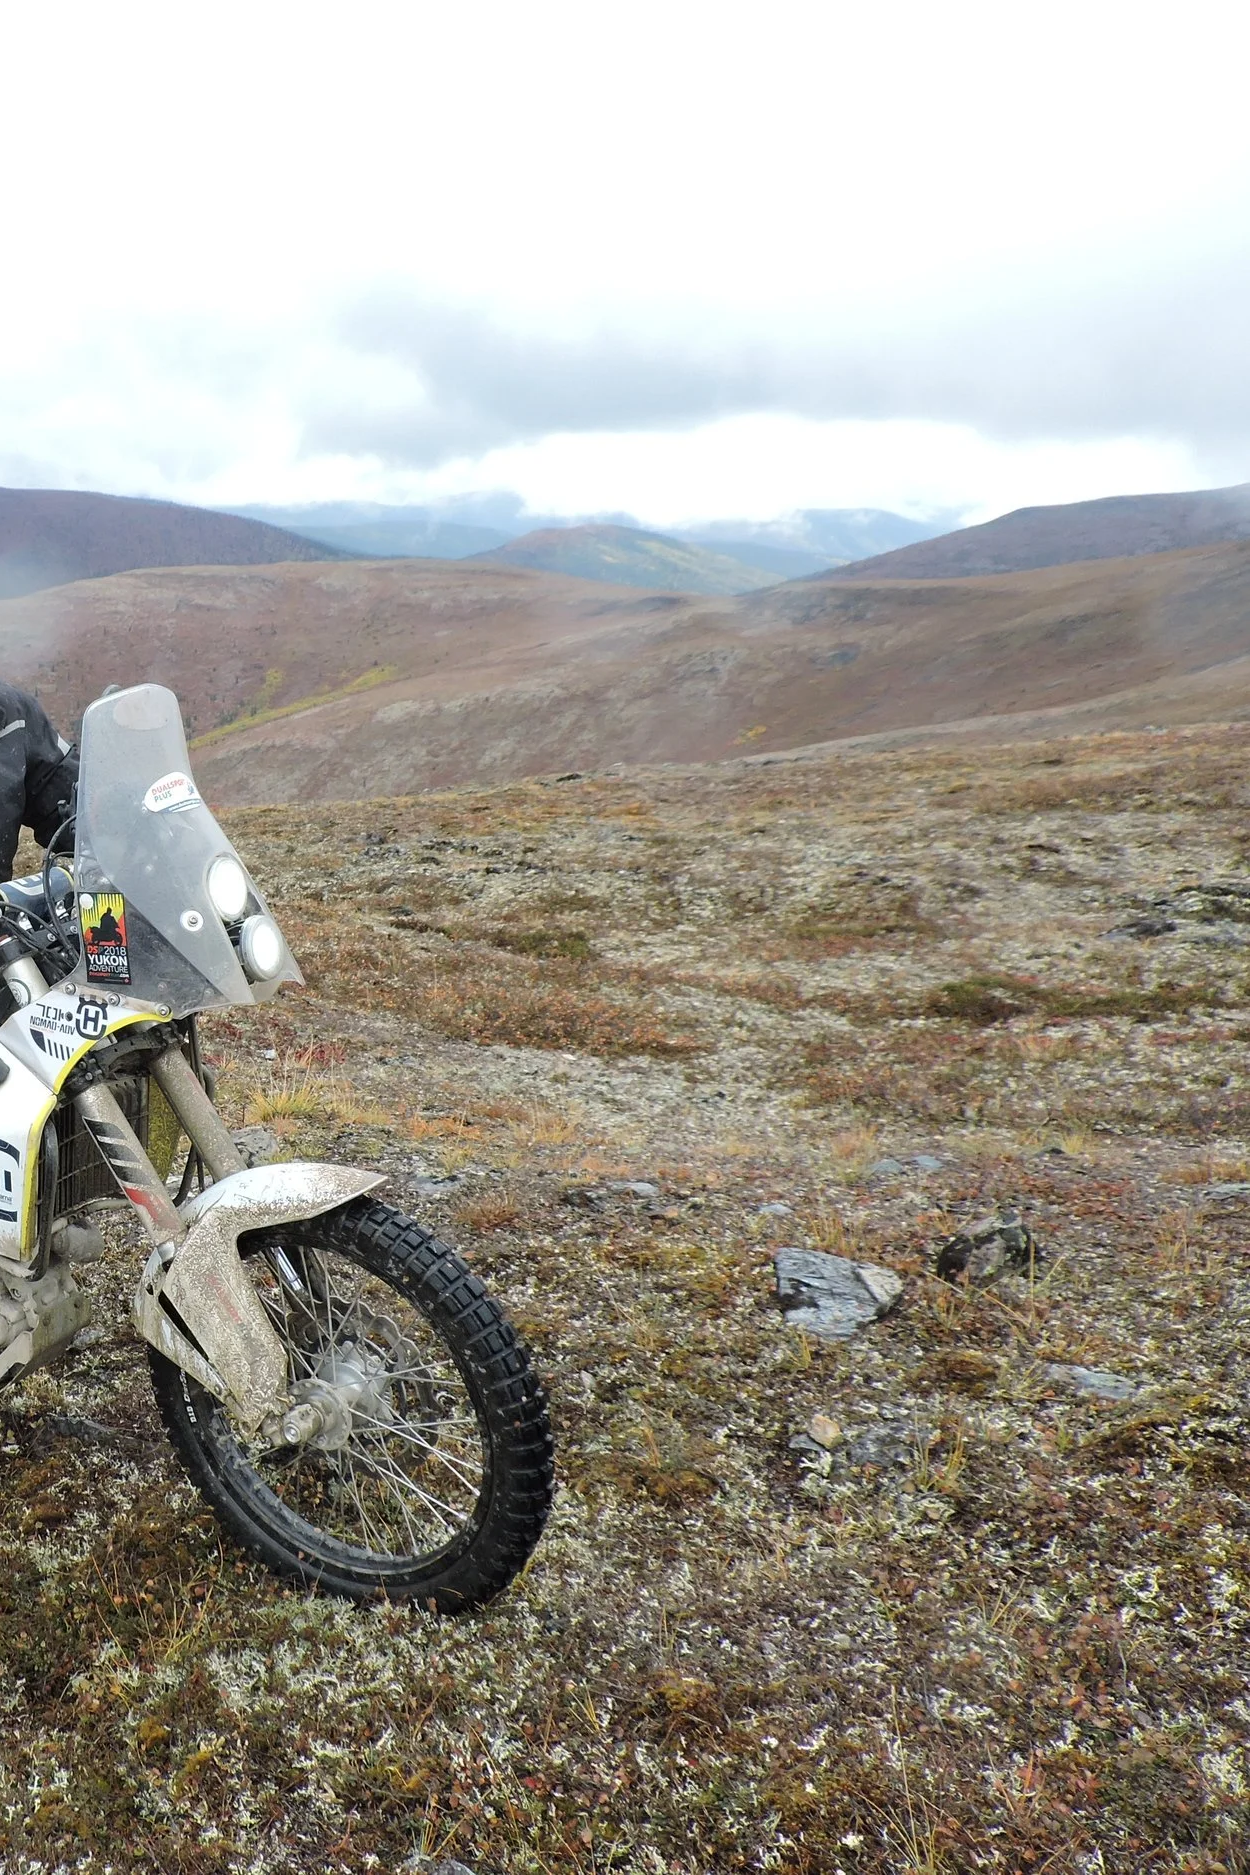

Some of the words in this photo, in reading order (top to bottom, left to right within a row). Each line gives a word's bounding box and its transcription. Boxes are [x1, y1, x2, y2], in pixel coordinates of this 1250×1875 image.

[154, 790, 172, 802] PLUS
[104, 946, 127, 957] 2018
[87, 954, 128, 966] YUKON
[88, 964, 129, 974] ADVENTURE
[29, 1015, 76, 1036] NOMAD-ADV
